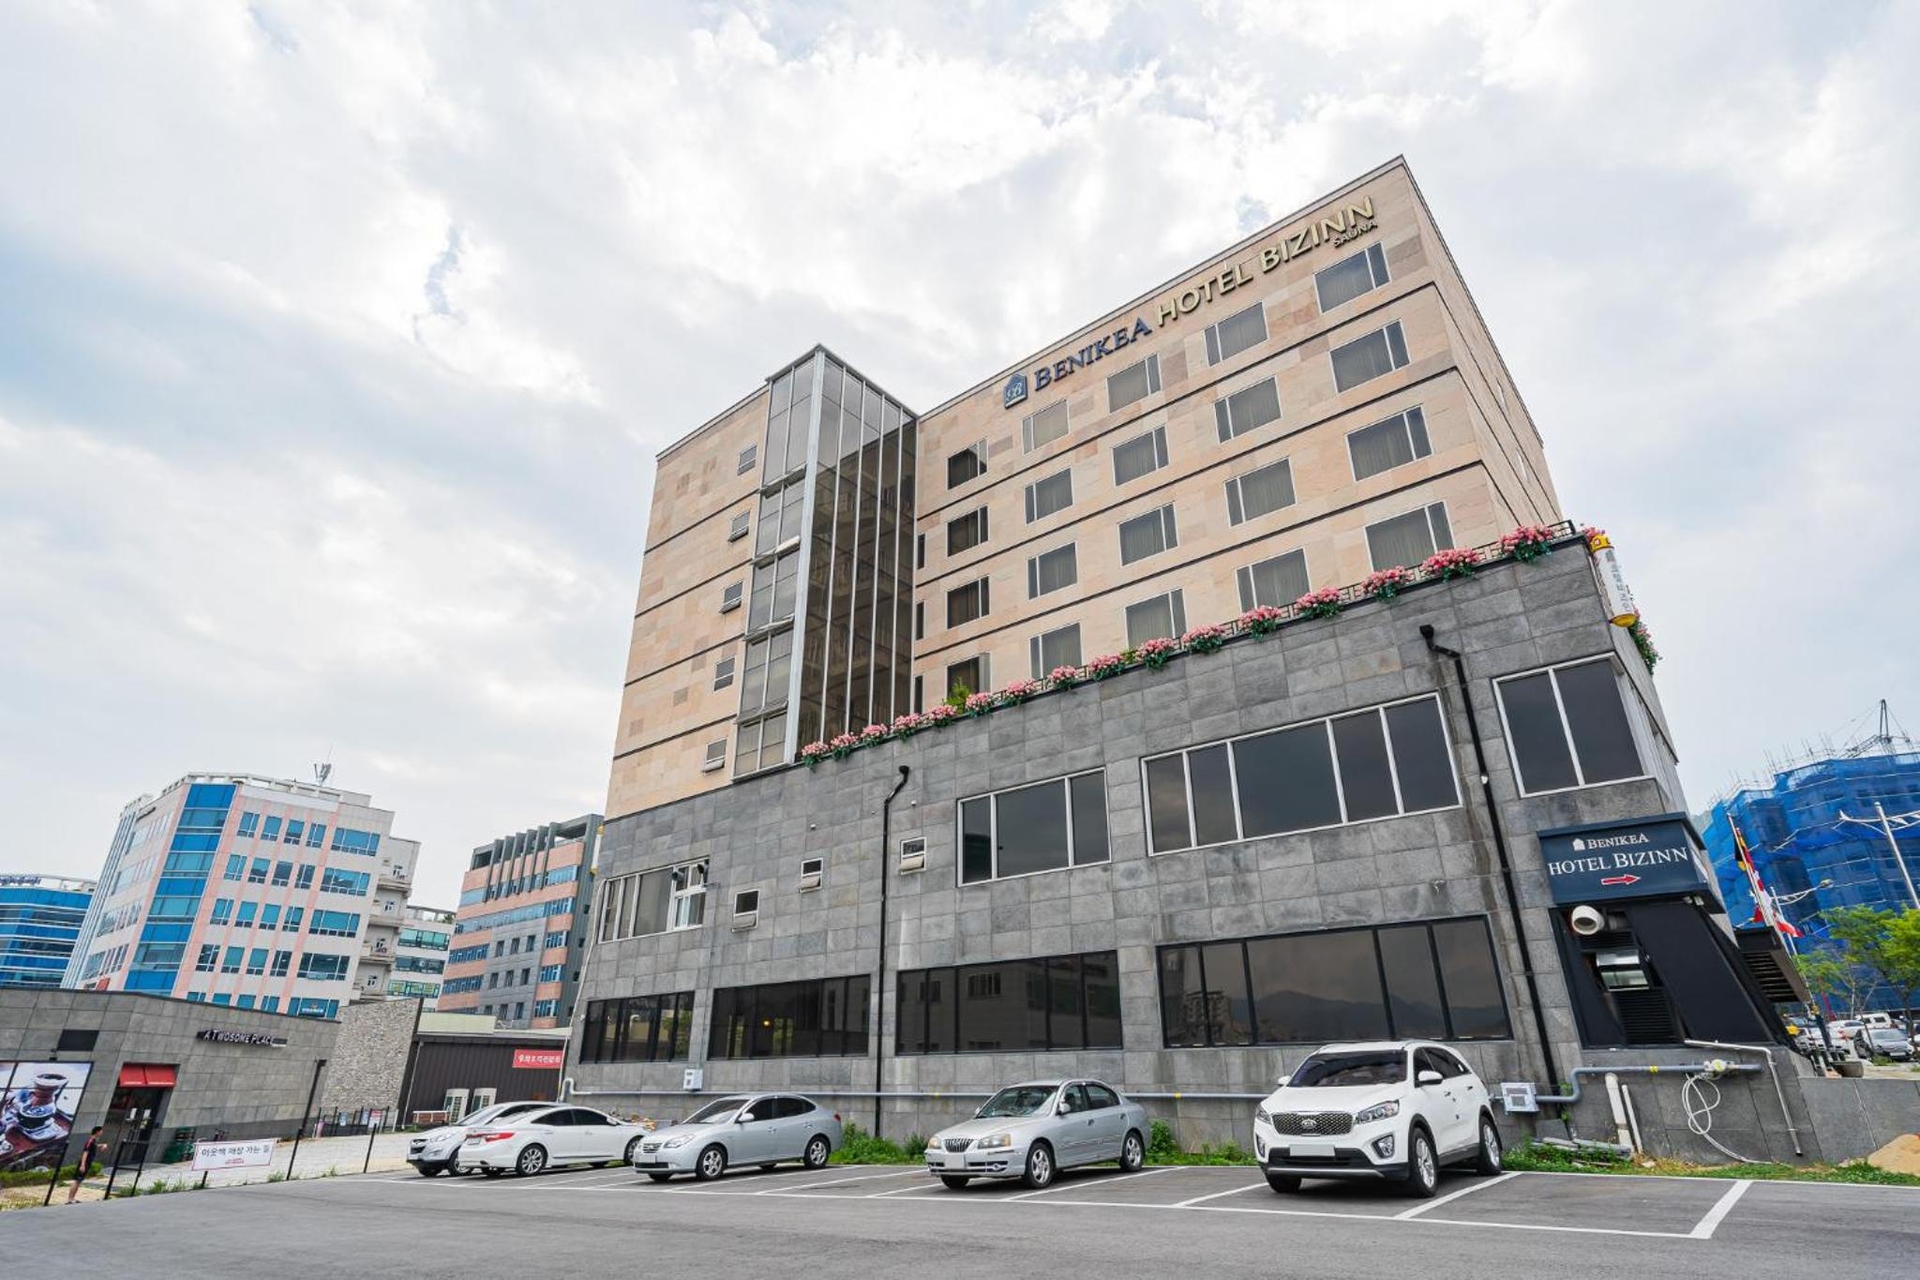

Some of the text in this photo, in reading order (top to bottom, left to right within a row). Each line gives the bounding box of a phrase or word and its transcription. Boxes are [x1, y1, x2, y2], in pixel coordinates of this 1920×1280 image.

[1333, 219, 1379, 249] SAUNA
[1034, 195, 1375, 392] BENIKEA HOTEL BIZINN
[1588, 833, 1649, 849] BENIKEA
[1548, 847, 1689, 875] HOTEL BIZINN
